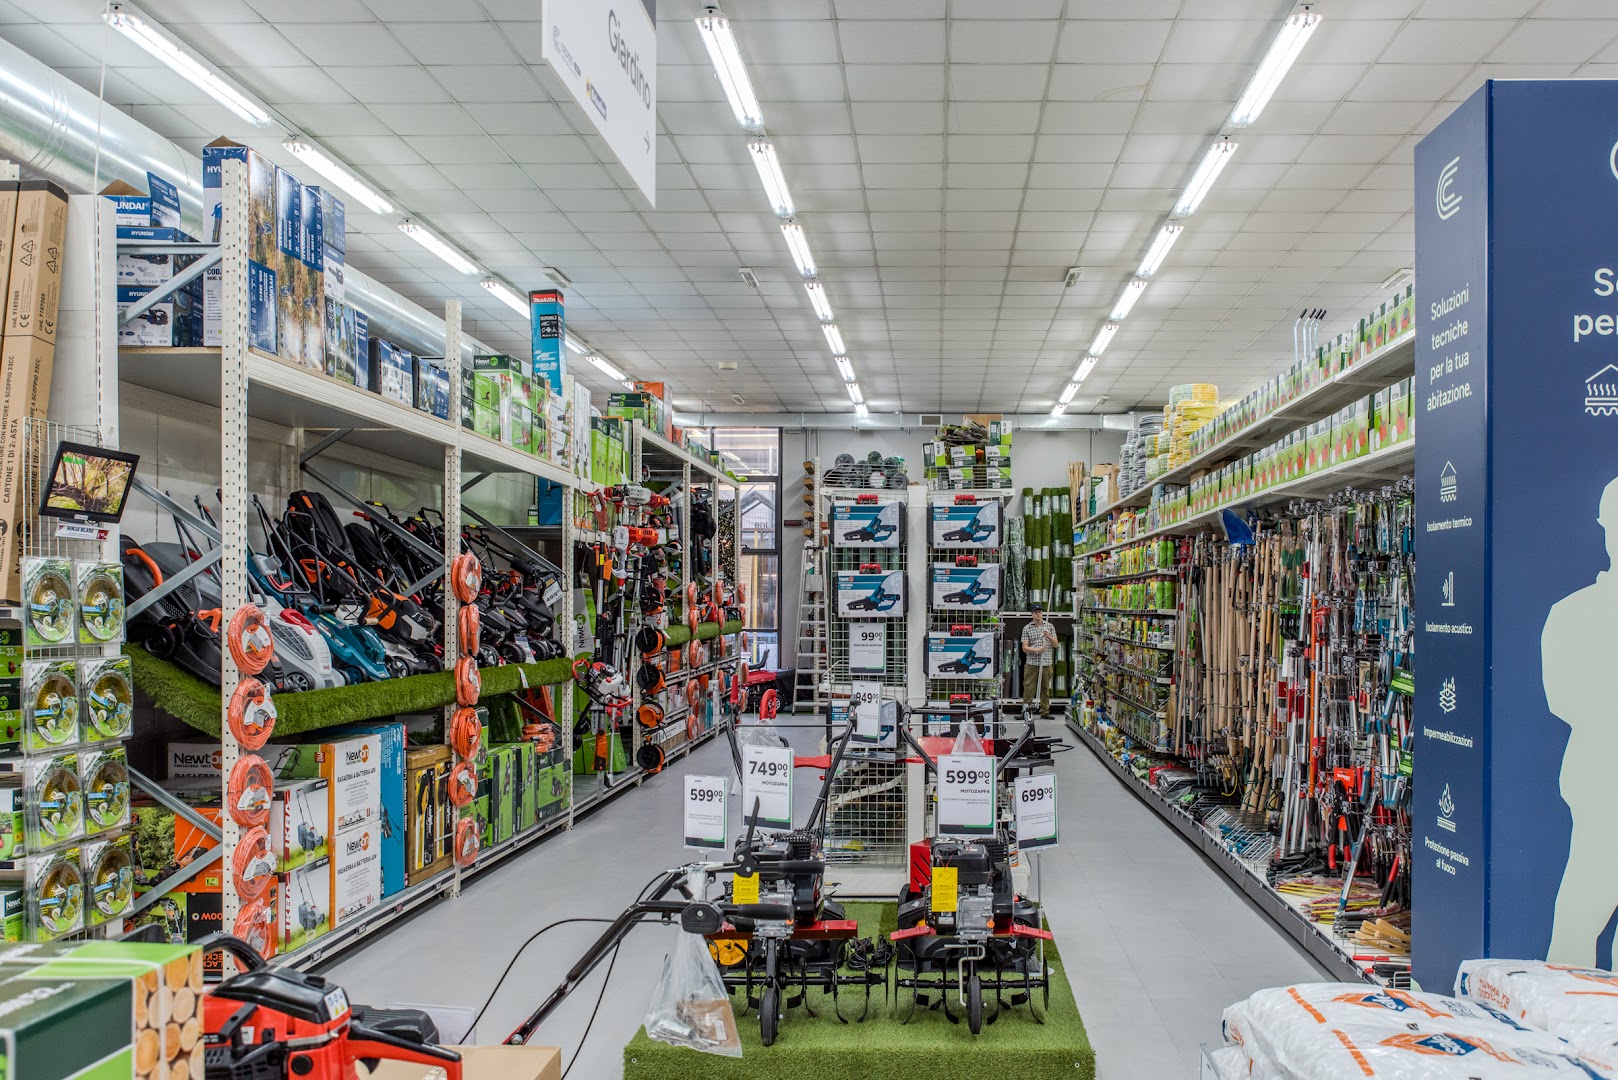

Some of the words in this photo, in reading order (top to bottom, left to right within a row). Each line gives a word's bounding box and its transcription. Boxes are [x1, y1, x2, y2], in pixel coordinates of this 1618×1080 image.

[608, 9, 651, 110] Giardino
[116, 201, 145, 210] UNDAI
[1430, 283, 1469, 321] Soluzioni
[1431, 319, 1469, 350] tecniche
[1573, 313, 1618, 343] pe
[1430, 360, 1445, 385] per
[1445, 357, 1453, 374] la
[1454, 350, 1470, 370] tua
[5, 371, 13, 399] SCOPPIO
[1427, 382, 1473, 412] abitazione.
[3, 466, 13, 504] CARTONE
[1426, 519, 1452, 532] Isolamento
[1452, 516, 1473, 528] termico
[1425, 621, 1450, 633] Isolamento
[1450, 623, 1473, 634] acustico
[1423, 725, 1473, 749] Impermeabilizzazioni
[345, 745, 369, 762] Newton
[346, 833, 370, 850] Newton
[1424, 836, 1450, 857] Protezione
[1449, 849, 1469, 867] passiva
[1435, 858, 1441, 869] al
[1441, 859, 1456, 876] fuoco
[200, 912, 222, 920] 00W
[203, 961, 222, 969] LACK
